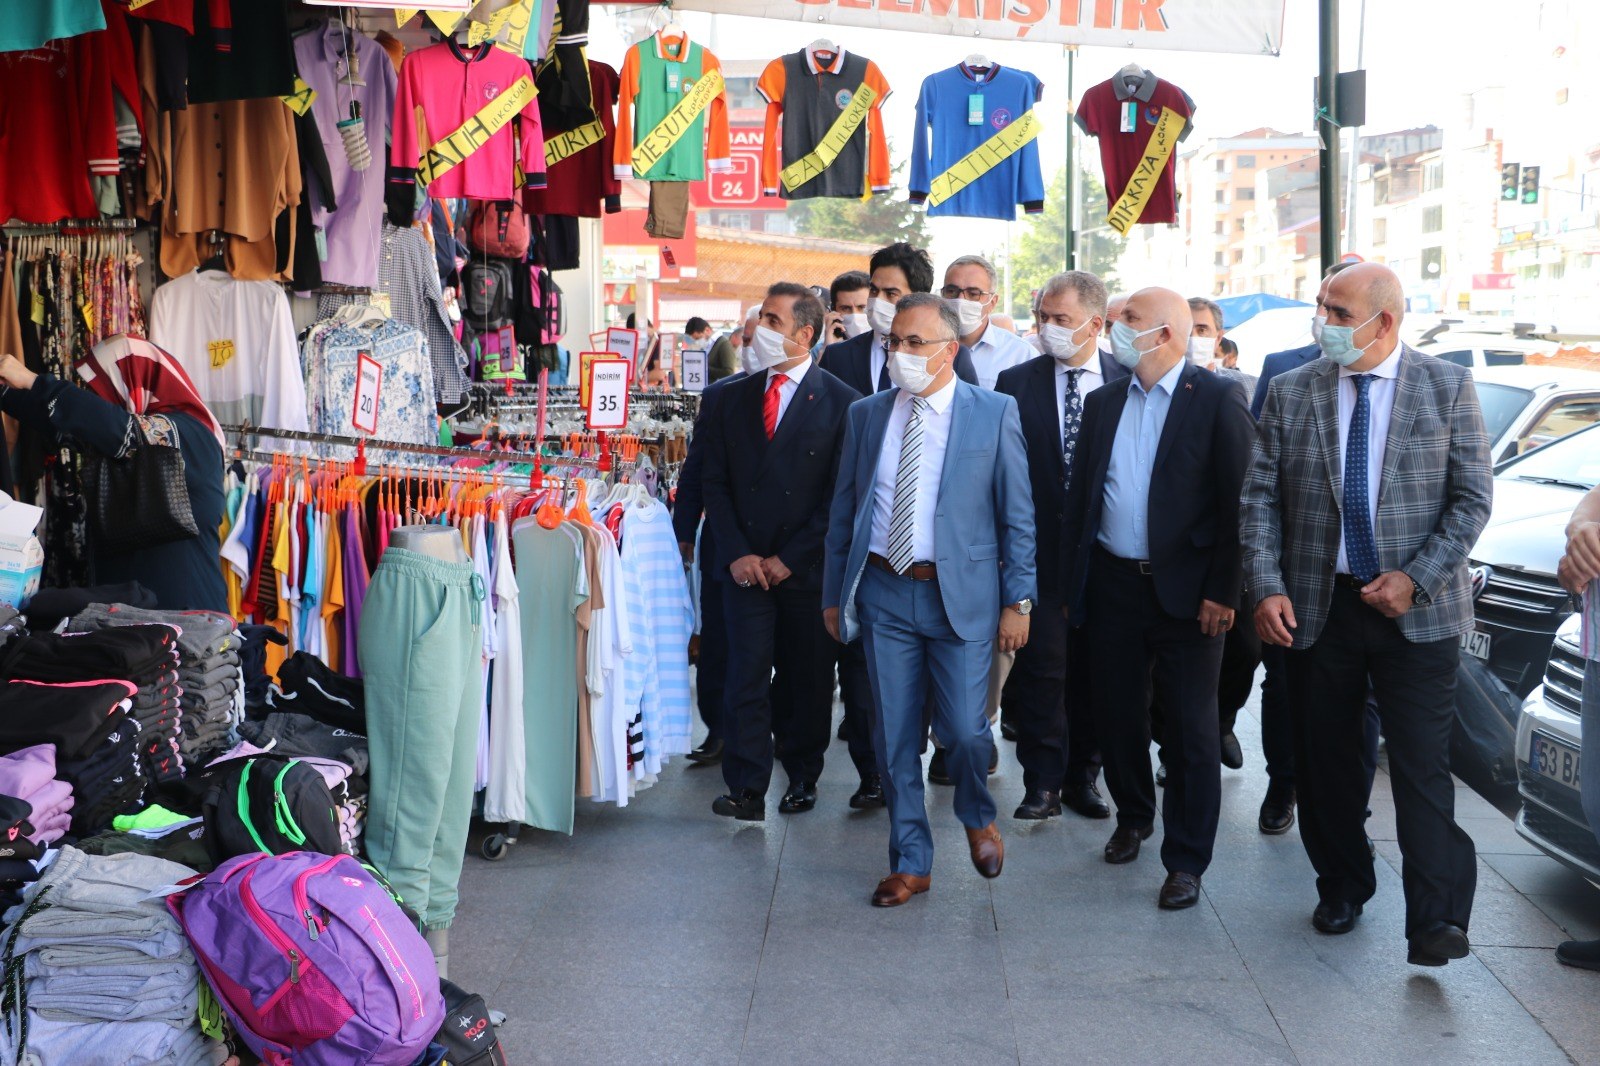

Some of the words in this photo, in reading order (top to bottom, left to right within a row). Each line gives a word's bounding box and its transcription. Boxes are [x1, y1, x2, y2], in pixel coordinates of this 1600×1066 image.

[631, 105, 690, 173] MESUT
[722, 181, 743, 197] 24
[689, 372, 700, 383] 25
[360, 394, 373, 415] 20
[598, 395, 617, 412] 35
[1469, 631, 1490, 657] 471
[1539, 741, 1558, 776] 53
